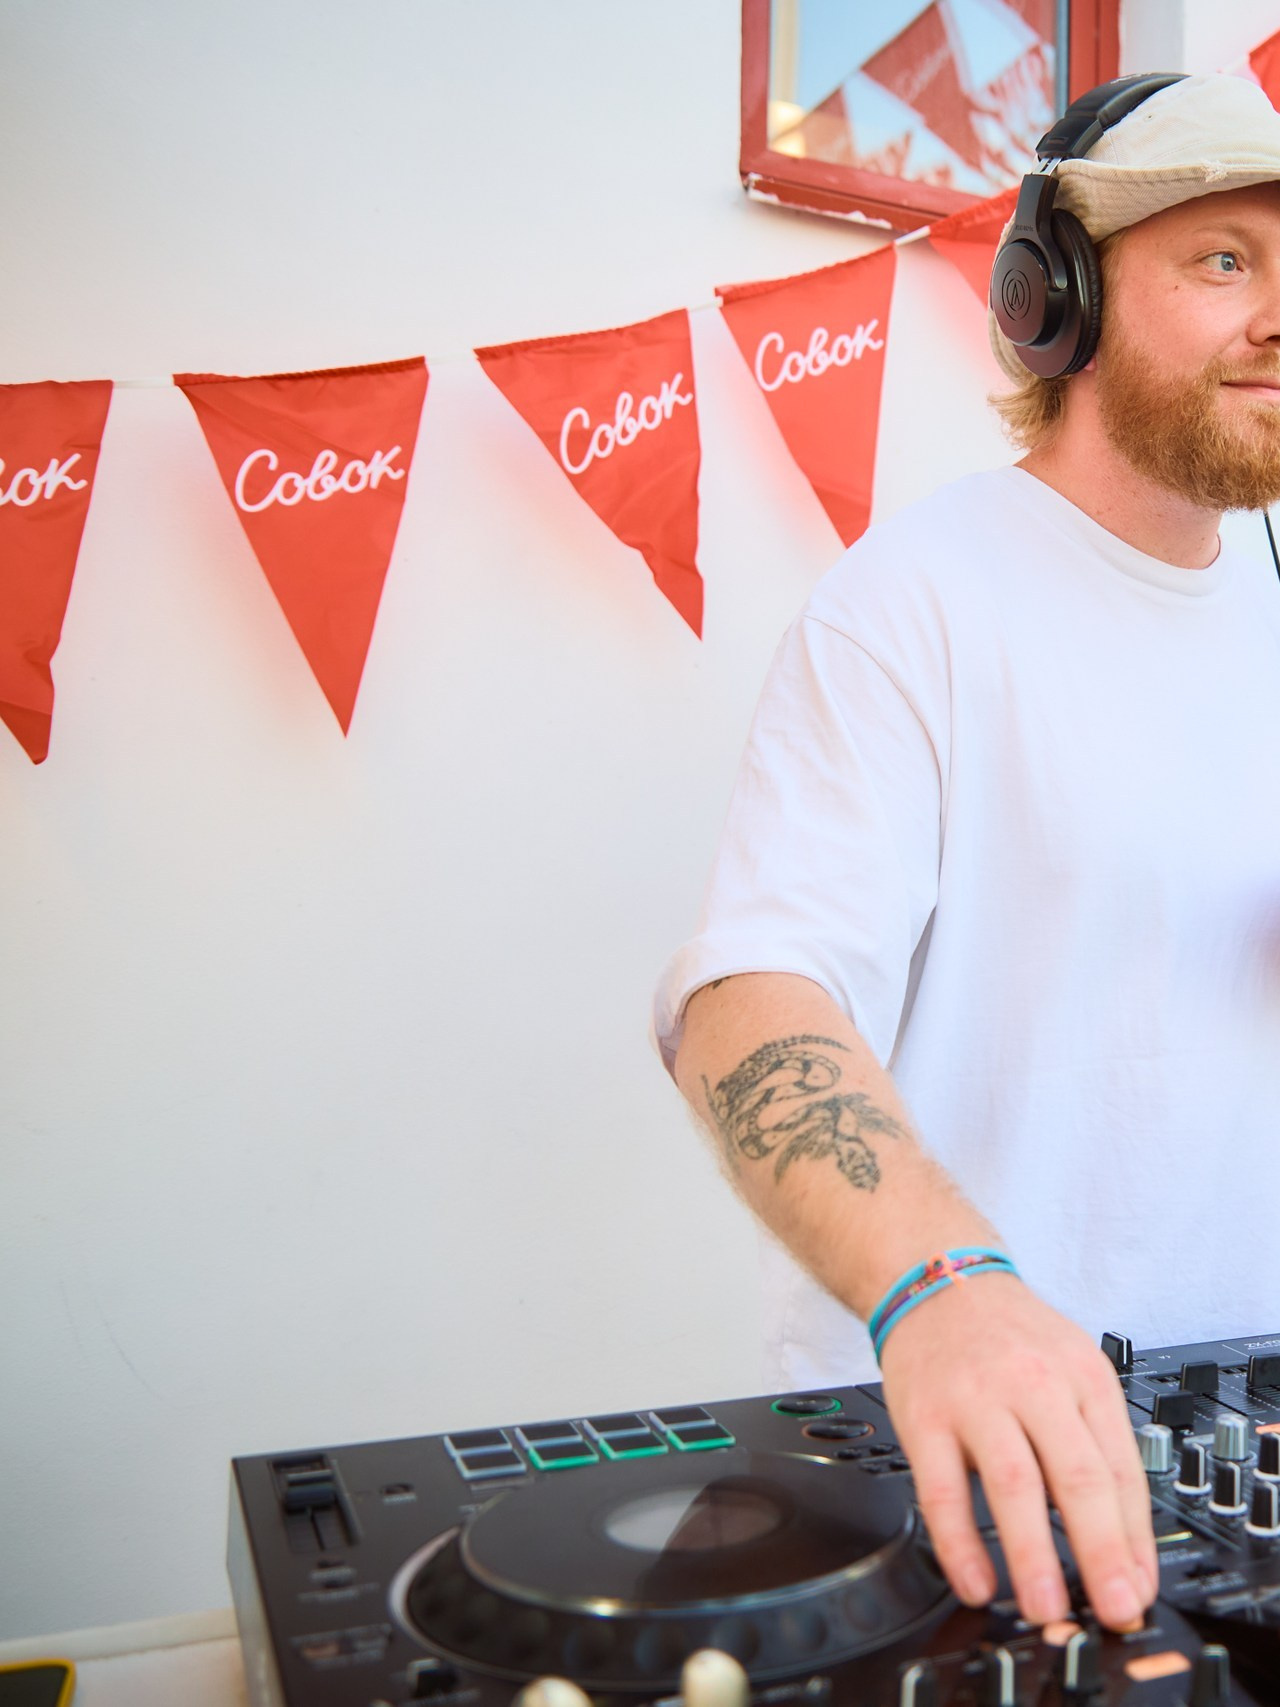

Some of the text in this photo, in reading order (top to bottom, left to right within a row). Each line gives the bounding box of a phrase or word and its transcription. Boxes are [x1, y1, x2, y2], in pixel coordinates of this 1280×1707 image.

[755, 319, 884, 392] Совок
[559, 373, 693, 474] Совок
[235, 445, 405, 513] Совок
